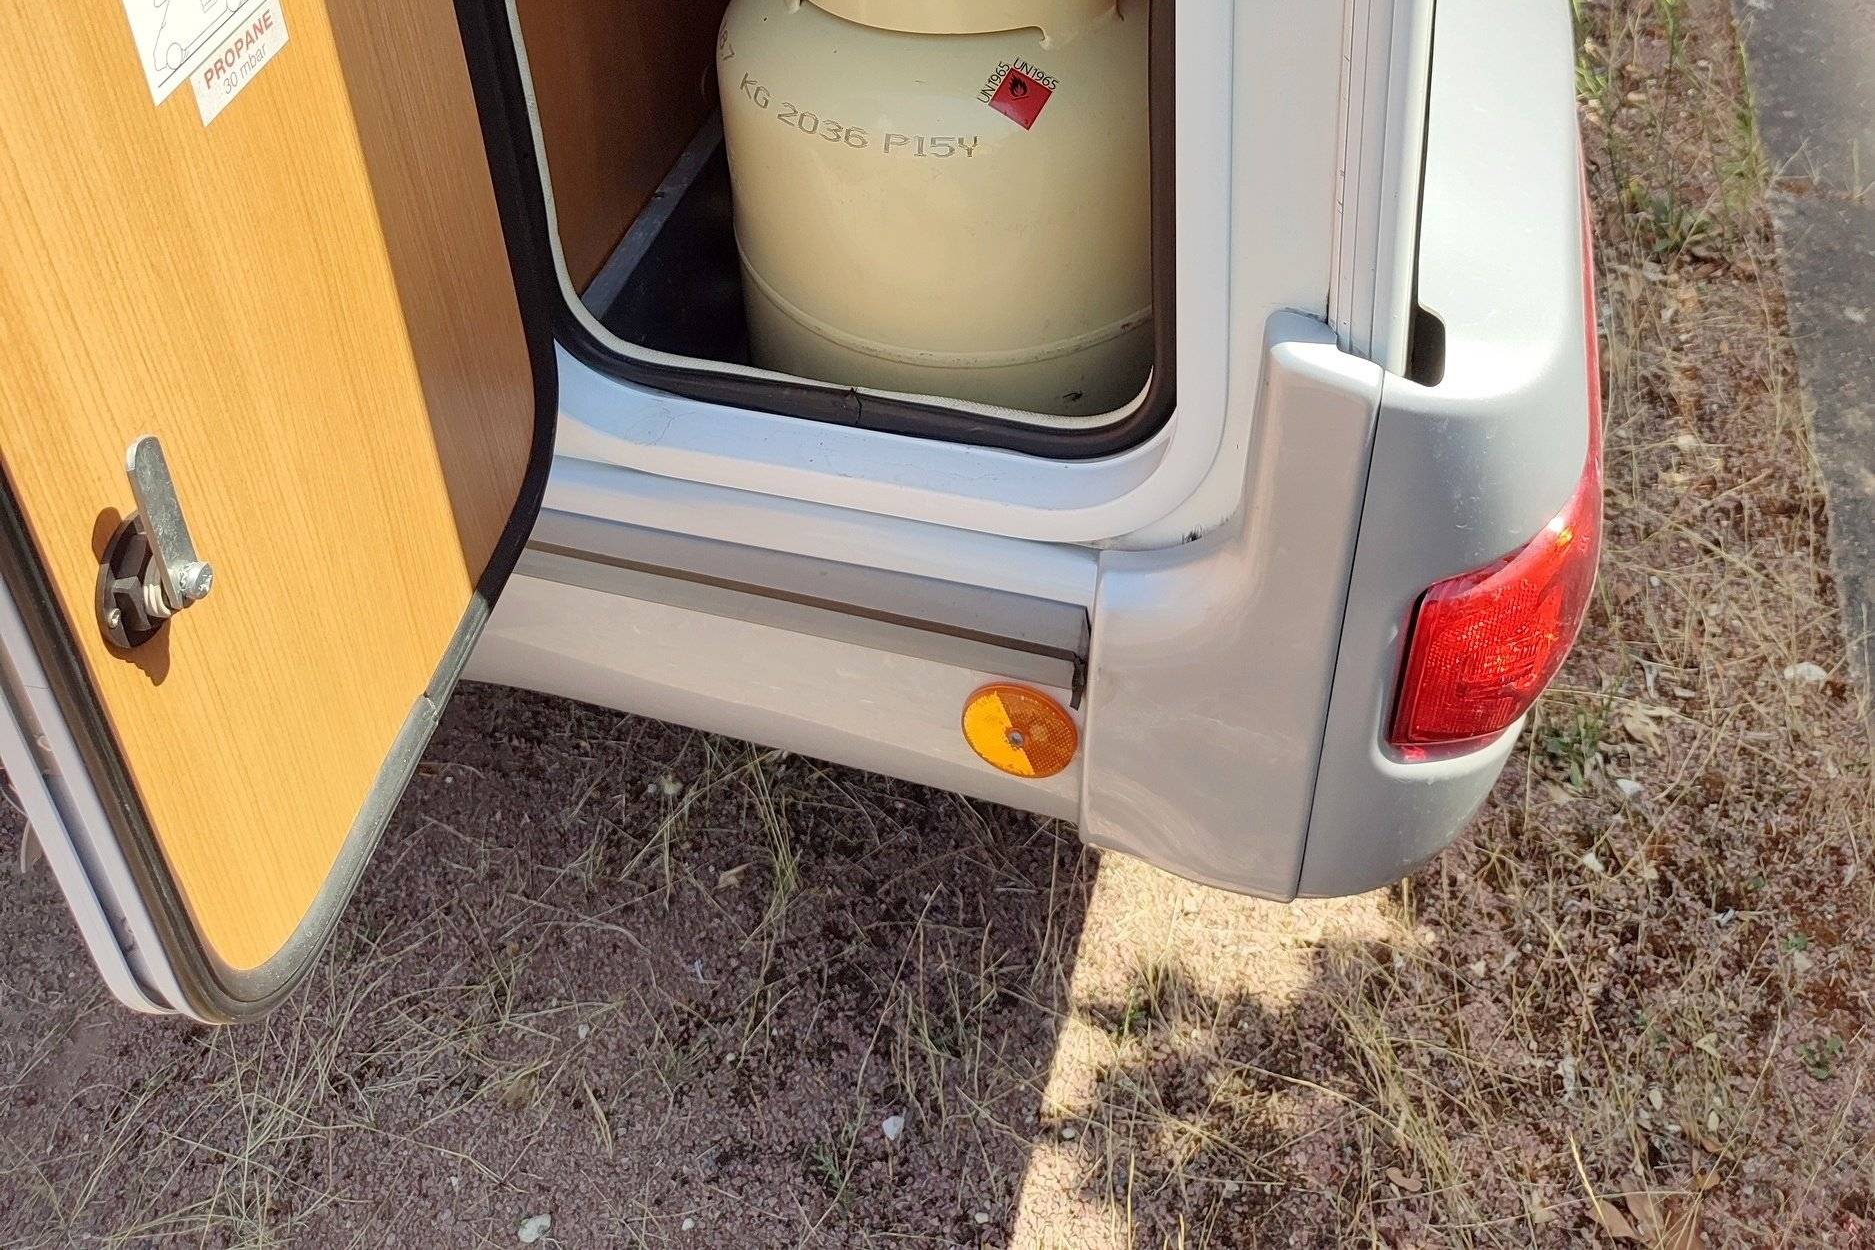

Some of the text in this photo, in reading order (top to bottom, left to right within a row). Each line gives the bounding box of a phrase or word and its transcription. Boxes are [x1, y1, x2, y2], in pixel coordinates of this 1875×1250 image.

[203, 9, 274, 90] PROPANE
[223, 43, 266, 95] 30 mbar
[1013, 58, 1060, 91] UN1965
[977, 61, 1010, 104] UN1965
[740, 72, 771, 109] KG
[777, 101, 868, 149] 2036
[883, 133, 978, 158] P15Y
